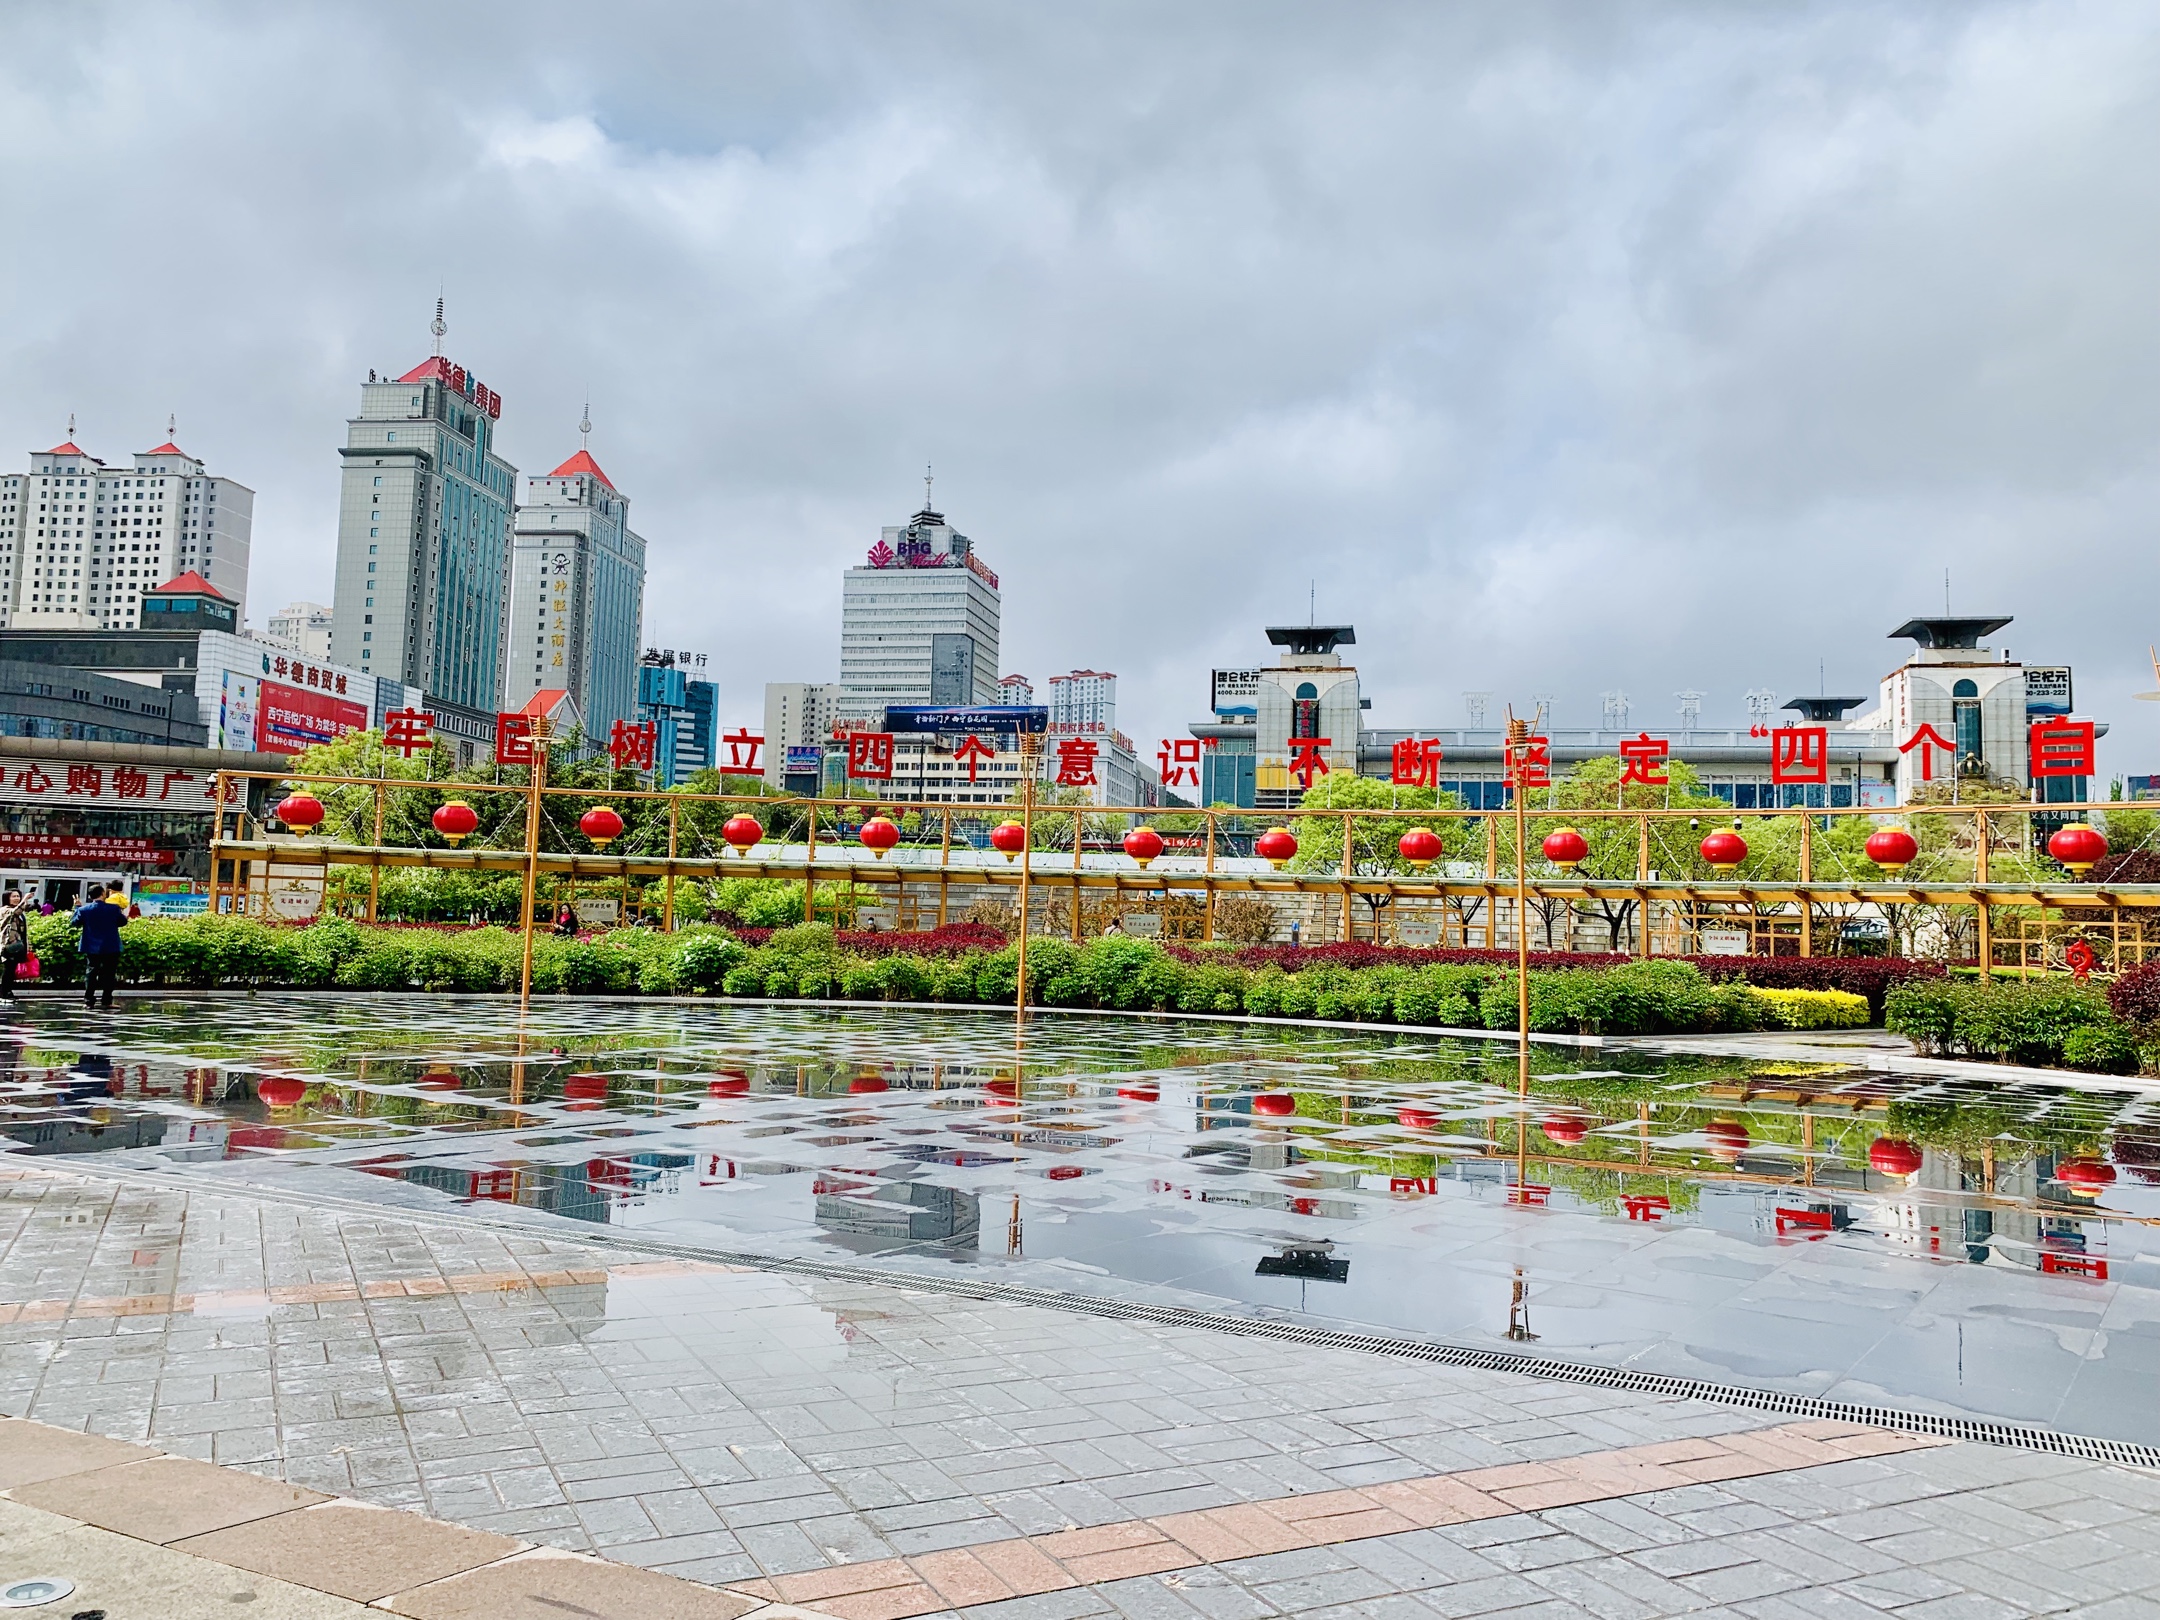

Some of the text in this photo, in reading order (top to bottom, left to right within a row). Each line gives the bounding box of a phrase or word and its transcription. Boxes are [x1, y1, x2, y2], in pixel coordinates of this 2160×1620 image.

[438, 355, 502, 420] 华德集团
[898, 542, 932, 555] BHG
[551, 579, 568, 667] 神旺大酒店
[646, 647, 708, 667] 发展银行
[274, 656, 347, 695] 华德商贸城
[267, 706, 314, 729] 西宁吾悦广场
